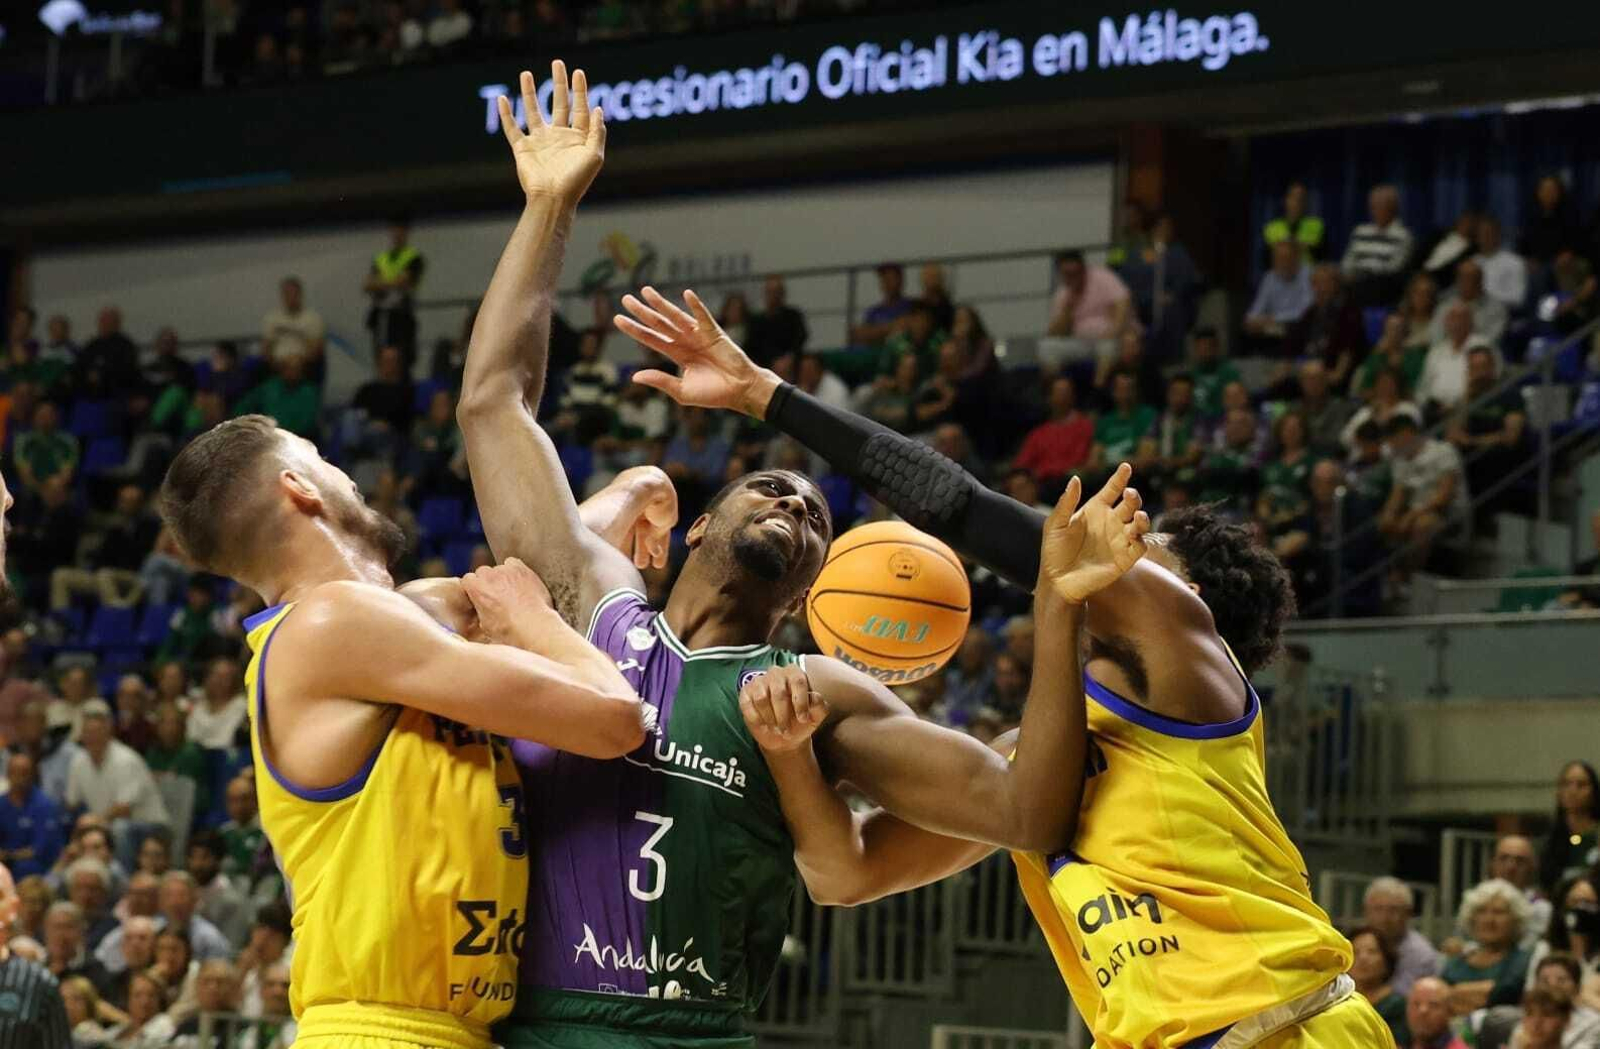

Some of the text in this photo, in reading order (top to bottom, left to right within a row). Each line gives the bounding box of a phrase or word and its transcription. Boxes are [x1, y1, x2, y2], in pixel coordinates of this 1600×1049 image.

[816, 34, 948, 100] Oficial
[956, 29, 1024, 84] Kia
[1032, 30, 1089, 76] en
[1098, 8, 1270, 70] Málaga.
[654, 739, 746, 788] Unicaja
[628, 810, 674, 902] 3
